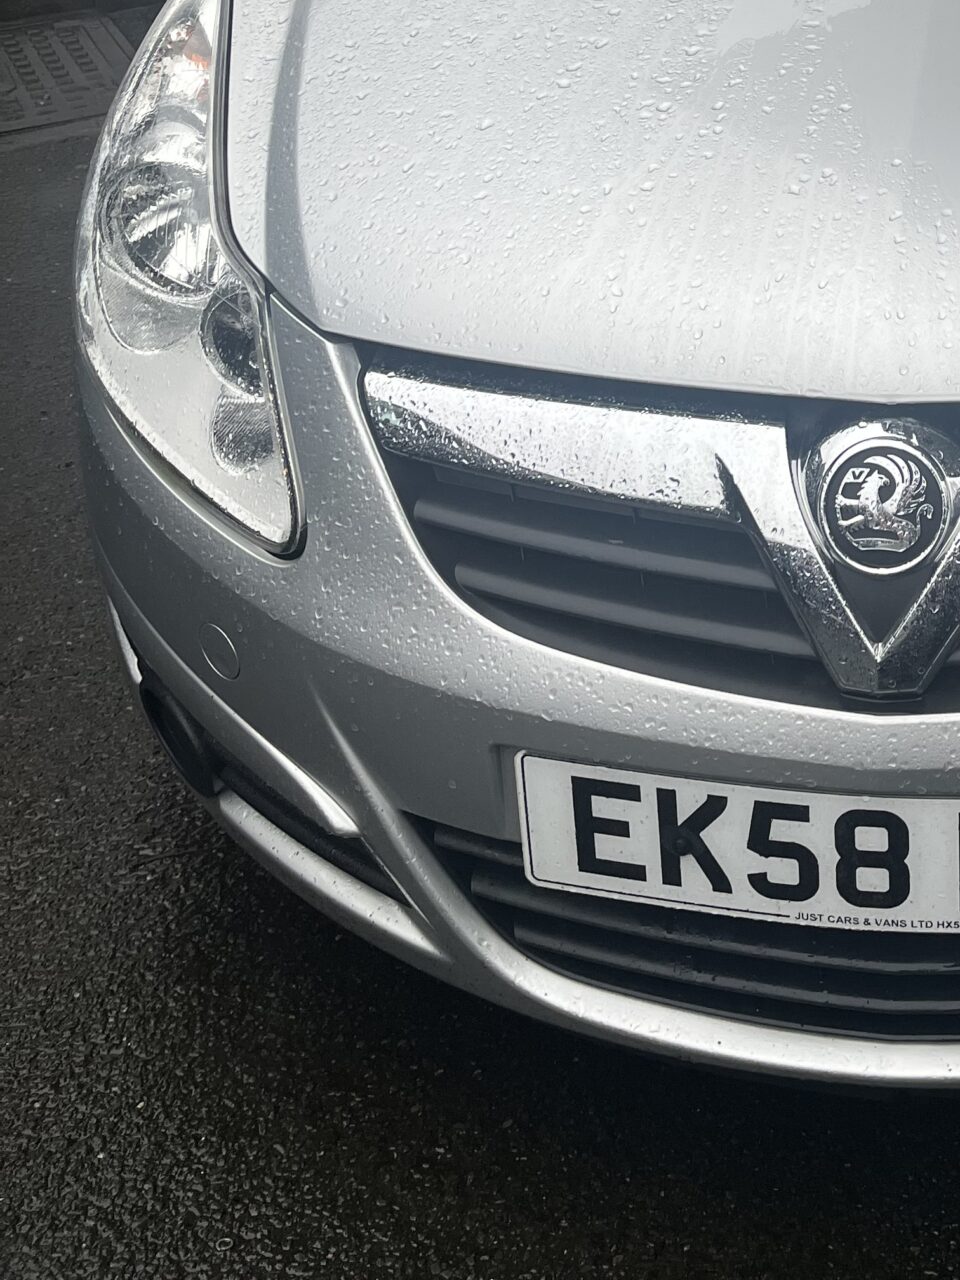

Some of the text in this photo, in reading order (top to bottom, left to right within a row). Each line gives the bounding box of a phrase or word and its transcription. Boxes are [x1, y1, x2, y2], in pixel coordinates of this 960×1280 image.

[570, 775, 911, 911] EK58
[795, 912, 824, 922] JUST
[827, 914, 860, 925] CARS
[863, 917, 871, 926] &
[874, 919, 908, 928] VANS
[910, 919, 934, 929] LTD
[936, 920, 960, 929] HX5
